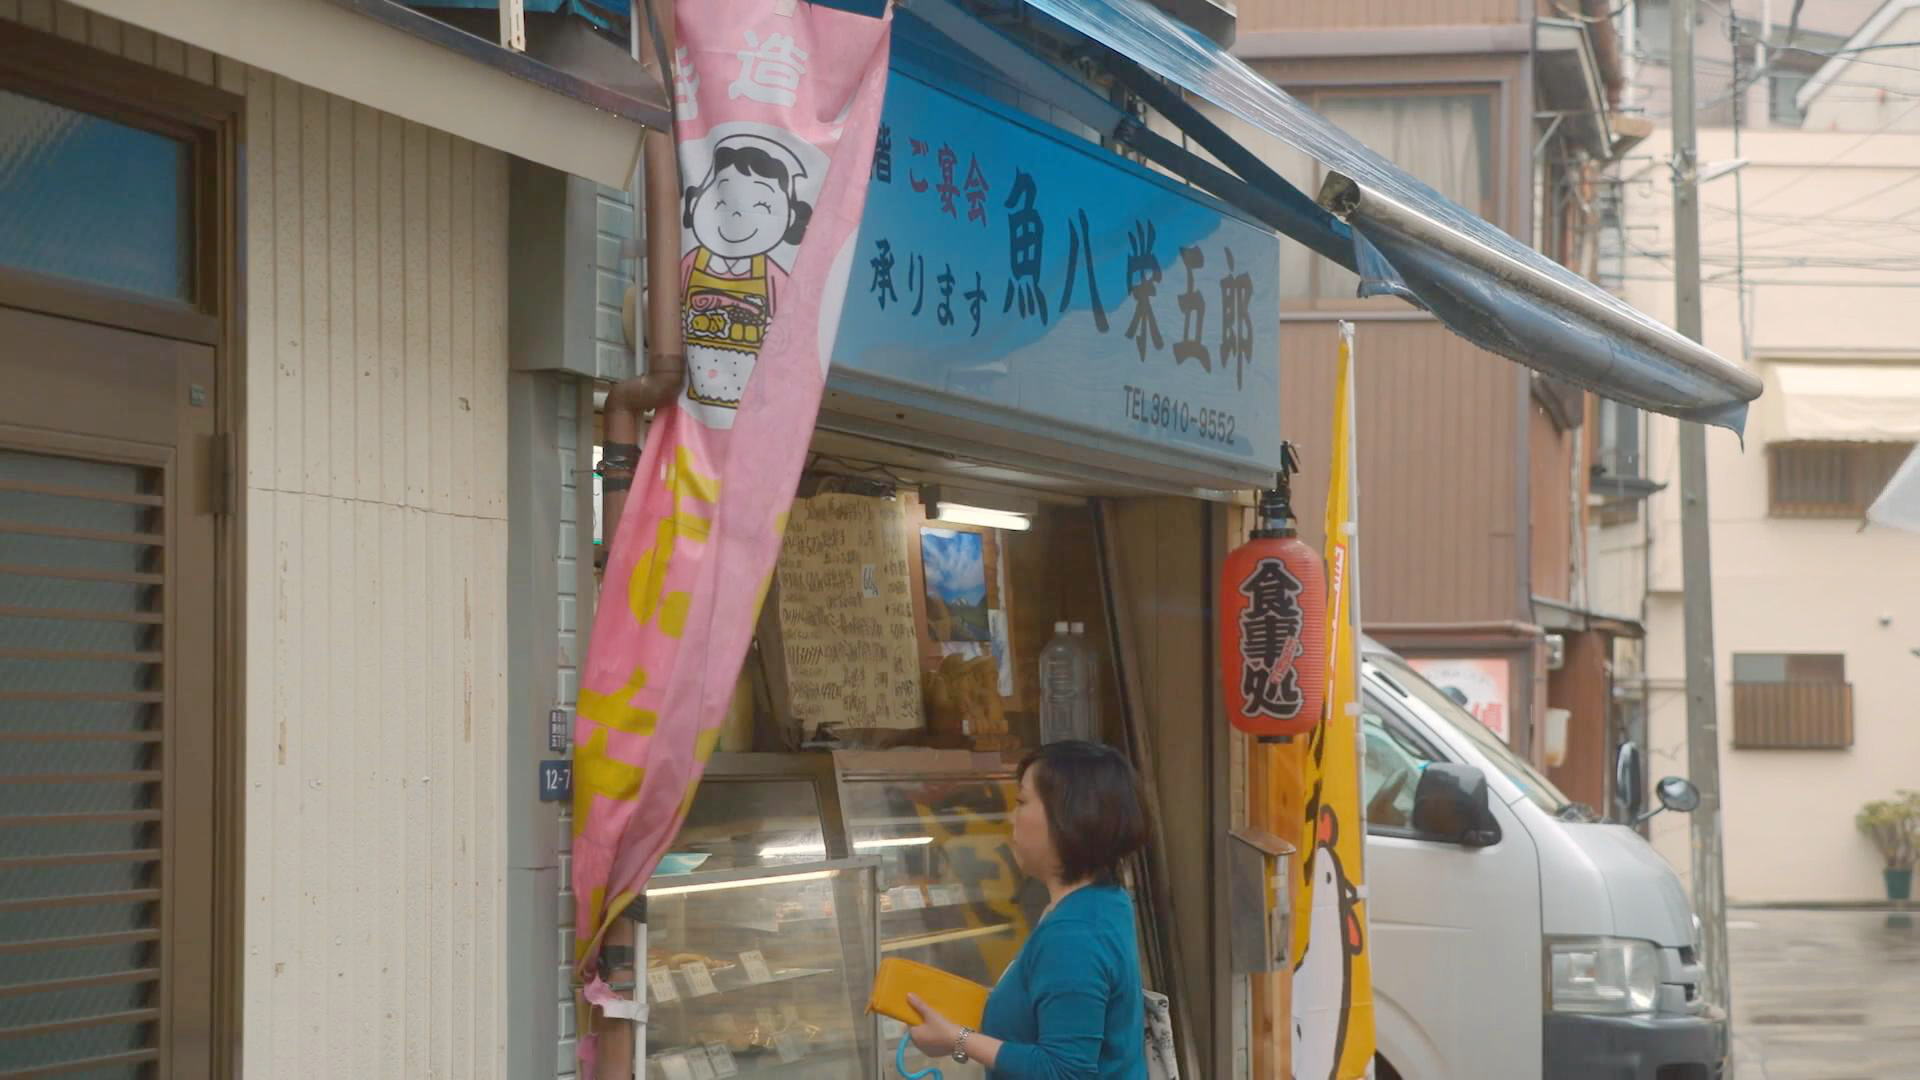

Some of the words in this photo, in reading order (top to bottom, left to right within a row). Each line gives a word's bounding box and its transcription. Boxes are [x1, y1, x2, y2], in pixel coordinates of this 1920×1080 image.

[868, 237, 988, 338] 承ります
[1002, 164, 1254, 391] 魚八栄五郎
[1239, 558, 1304, 719] 食事処
